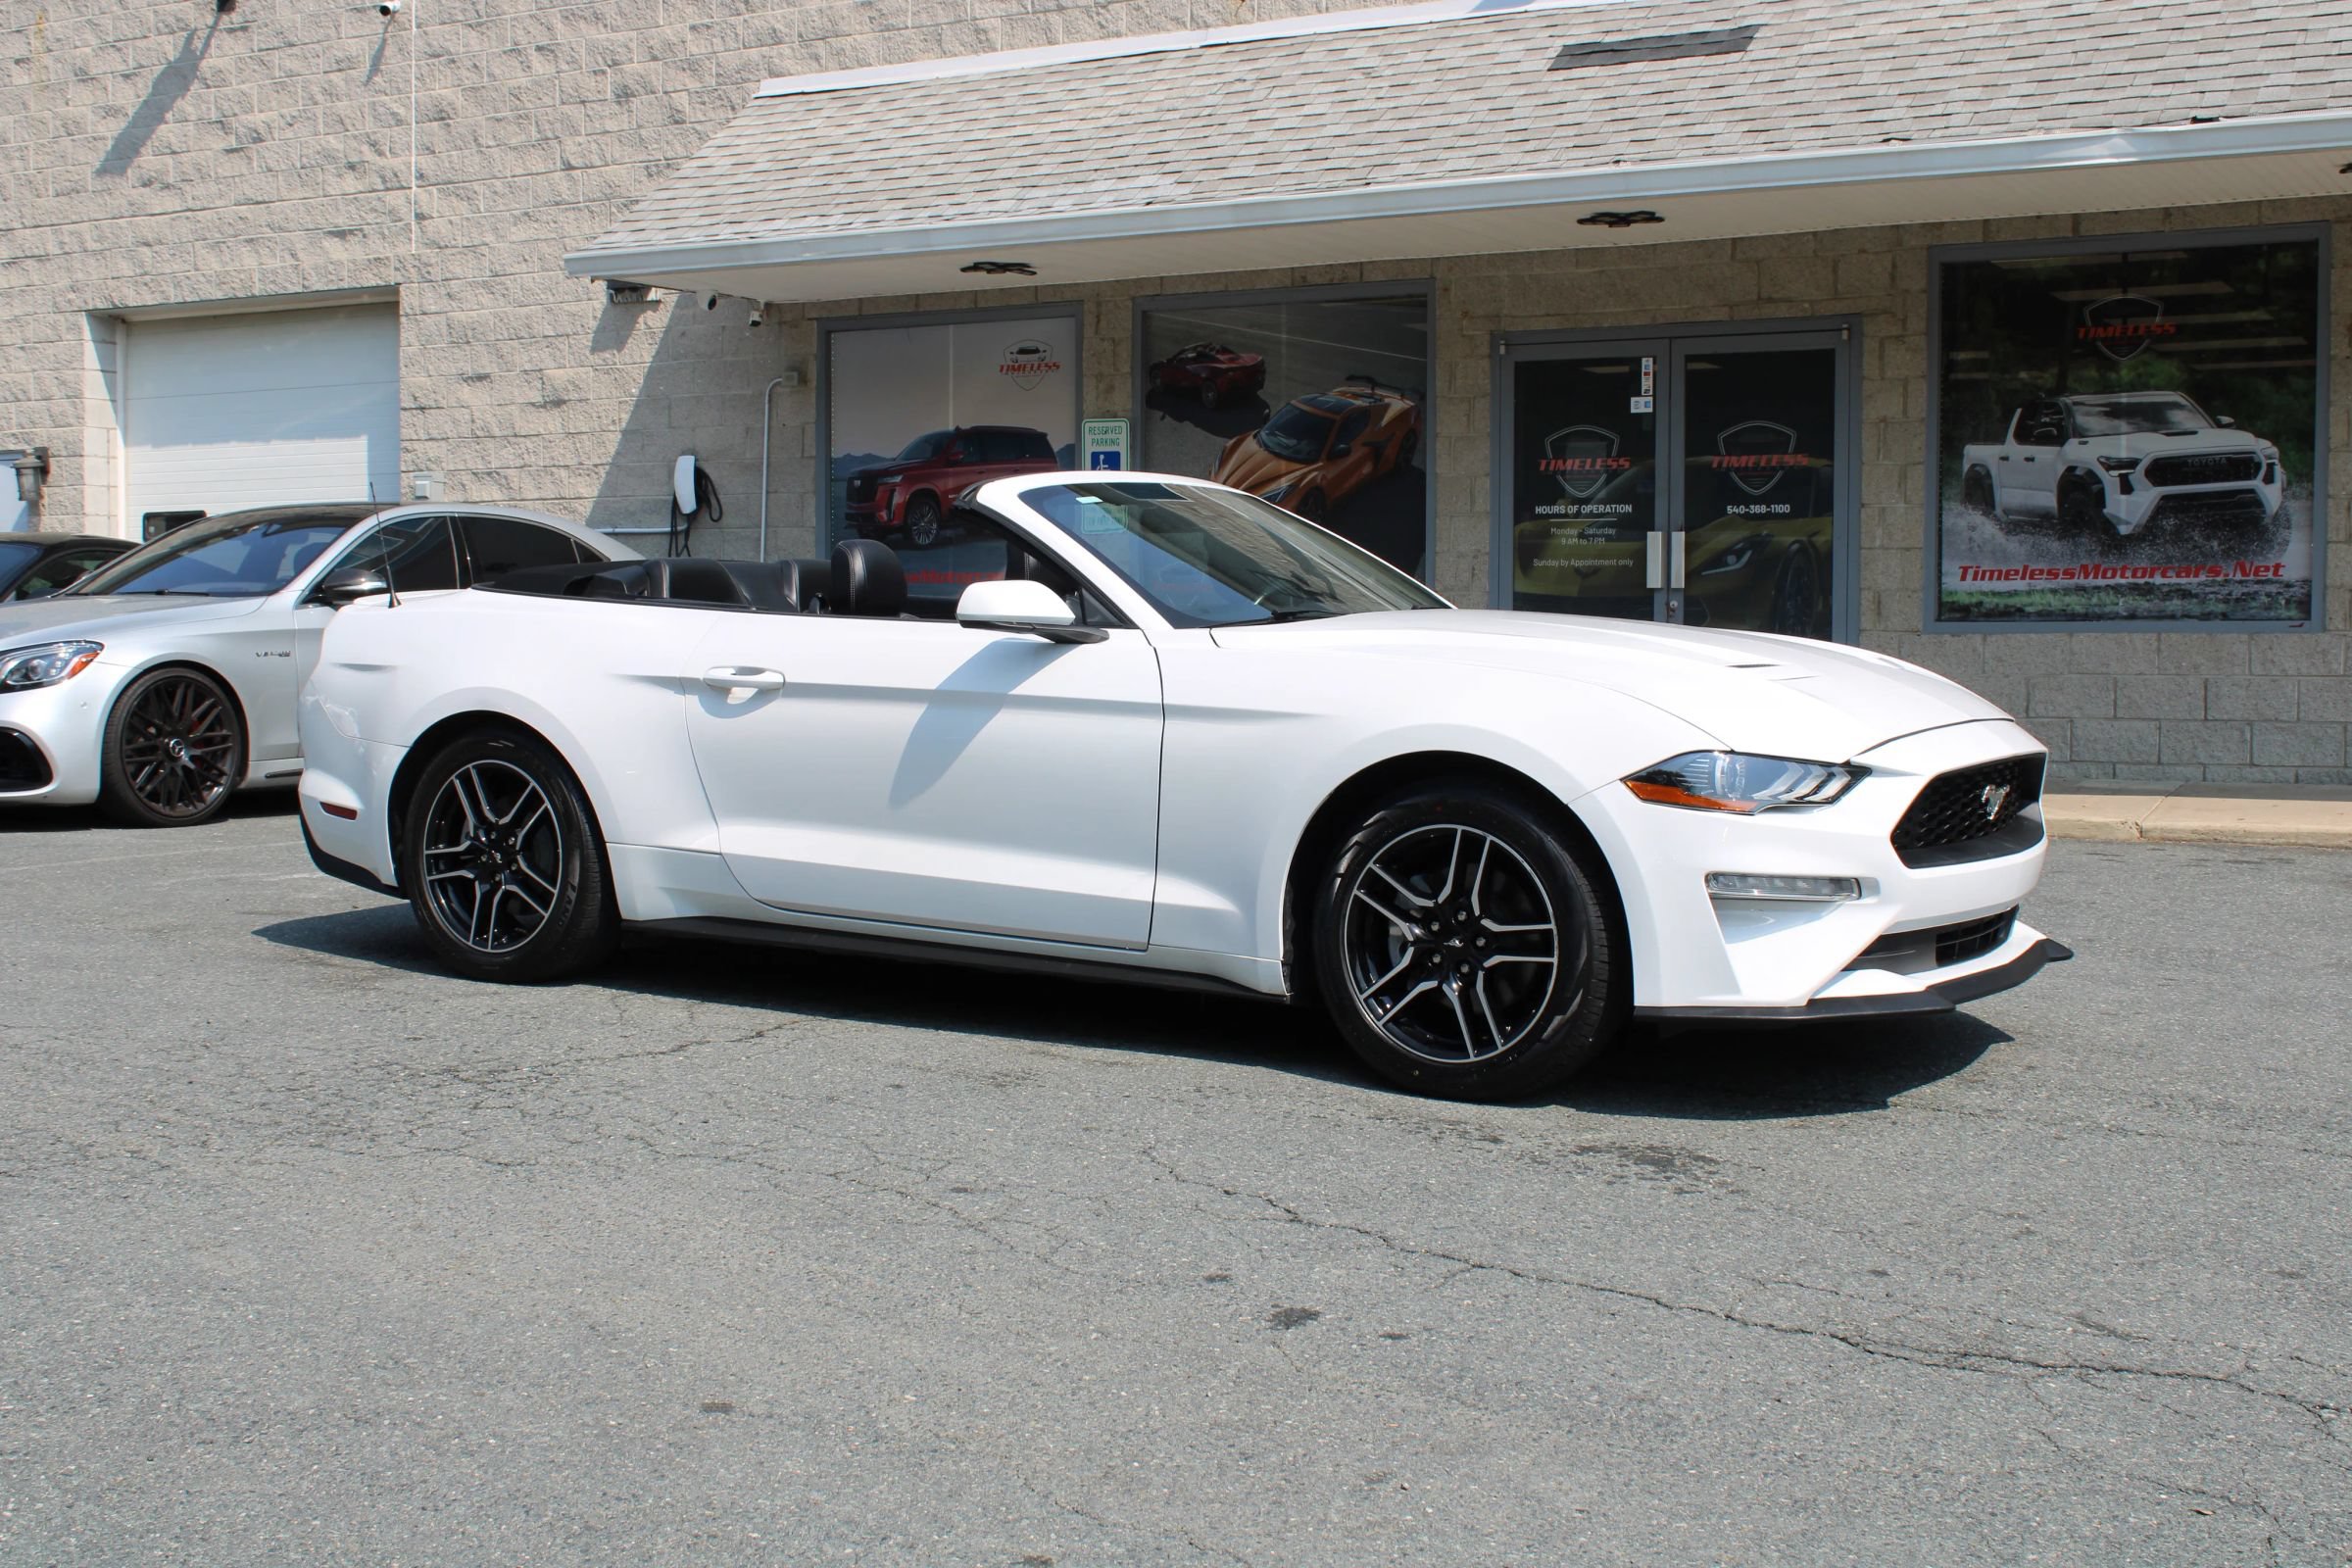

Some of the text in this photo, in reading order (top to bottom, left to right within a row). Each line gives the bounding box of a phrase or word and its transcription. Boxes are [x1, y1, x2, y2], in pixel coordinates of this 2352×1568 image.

[2076, 321, 2178, 340] TIMELESS
[999, 362, 1060, 372] TIMELESS
[1088, 425, 1123, 436] RESERVED
[1091, 437, 1120, 447] PARKING
[1539, 457, 1632, 471] TIMELESS
[1711, 453, 1809, 468] TIMELESS
[2186, 457, 2227, 468] TOYOTA
[1535, 504, 1633, 514] HOURS OF OPERATION
[1726, 504, 1790, 514] 540-368-1100
[1550, 527, 1578, 536] Monday
[1584, 527, 1616, 536] Saturday
[1533, 559, 1559, 567] Sunday
[1560, 559, 1569, 567] by
[1618, 558, 1634, 566] only
[1958, 560, 2286, 582] TimelessMotorcars.Net
